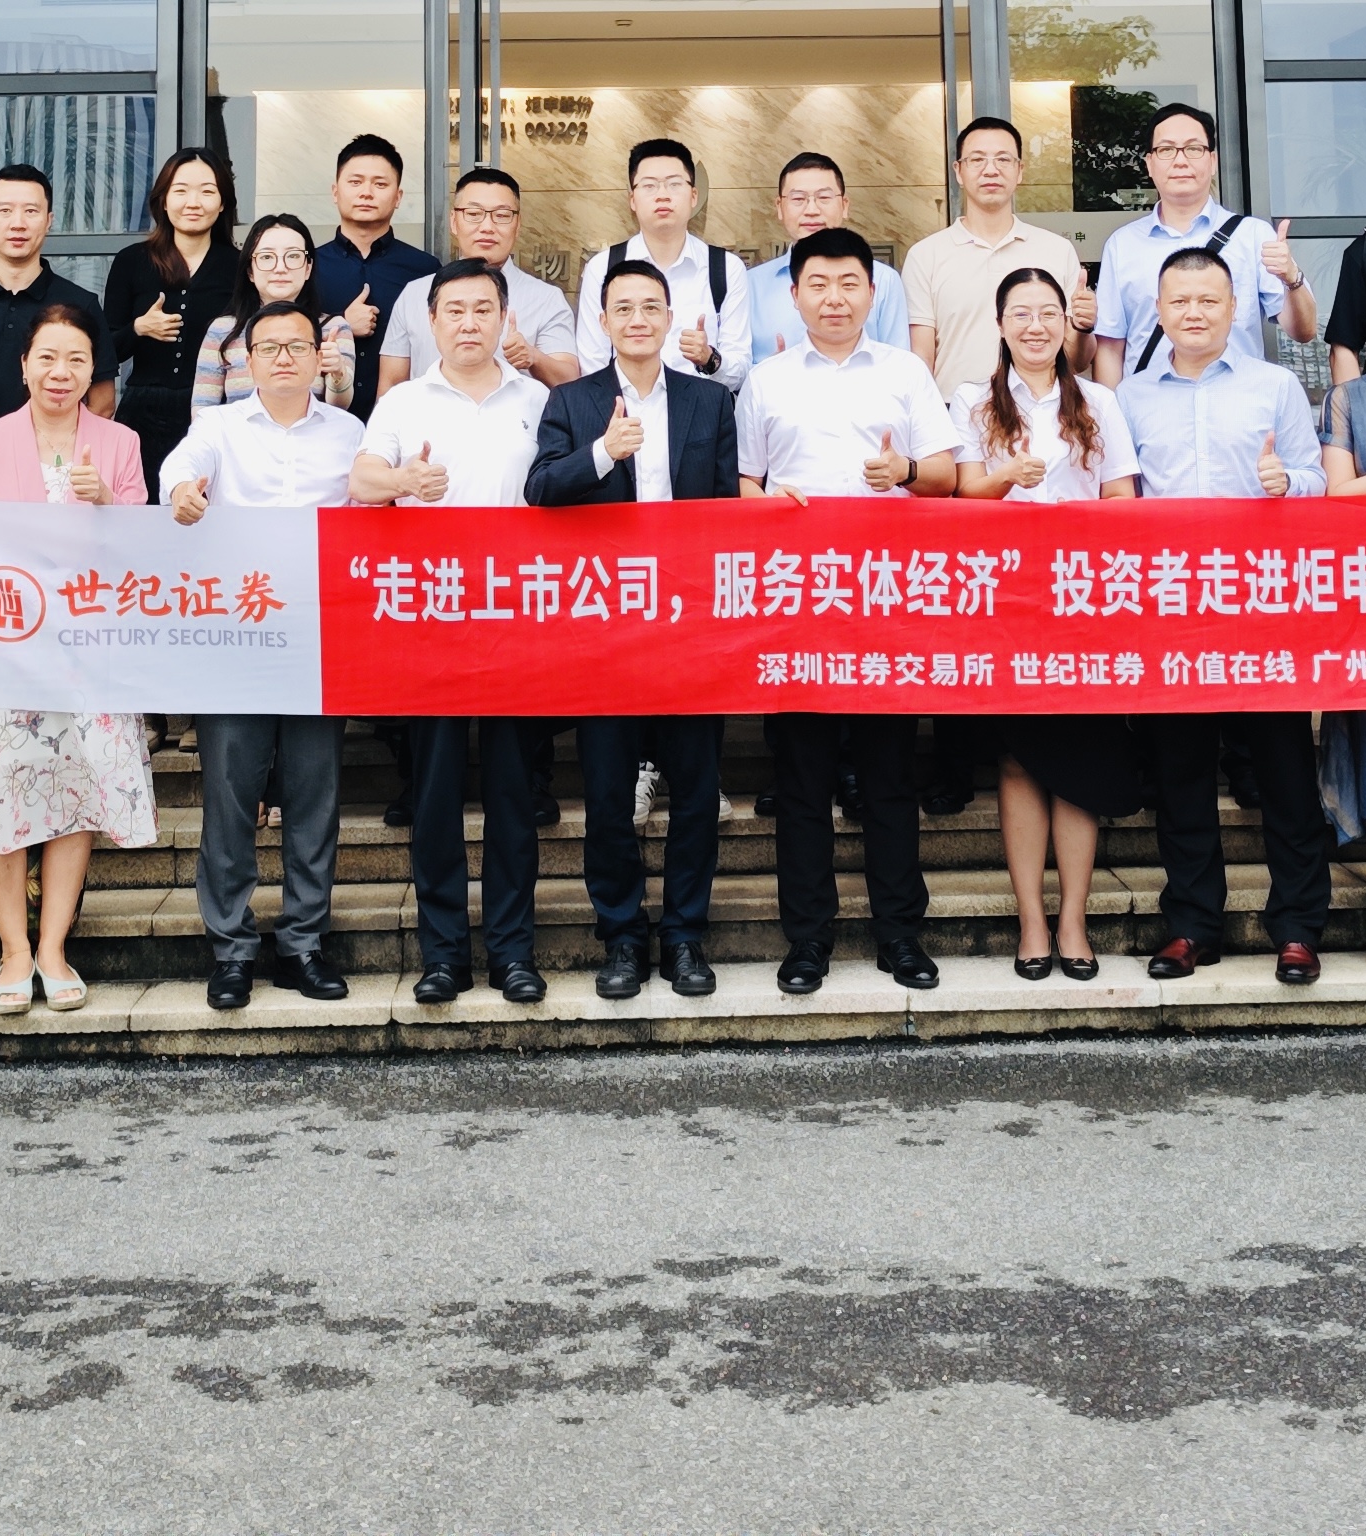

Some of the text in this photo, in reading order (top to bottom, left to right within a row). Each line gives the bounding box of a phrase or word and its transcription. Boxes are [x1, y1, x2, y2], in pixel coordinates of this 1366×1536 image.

[56, 568, 288, 625] 世纪证券
[57, 627, 288, 649] CENTURY SECURITIES
[756, 651, 995, 687] 深圳证券交易所
[1010, 650, 1146, 686] 世纪证券
[1161, 648, 1297, 685] 价值在线
